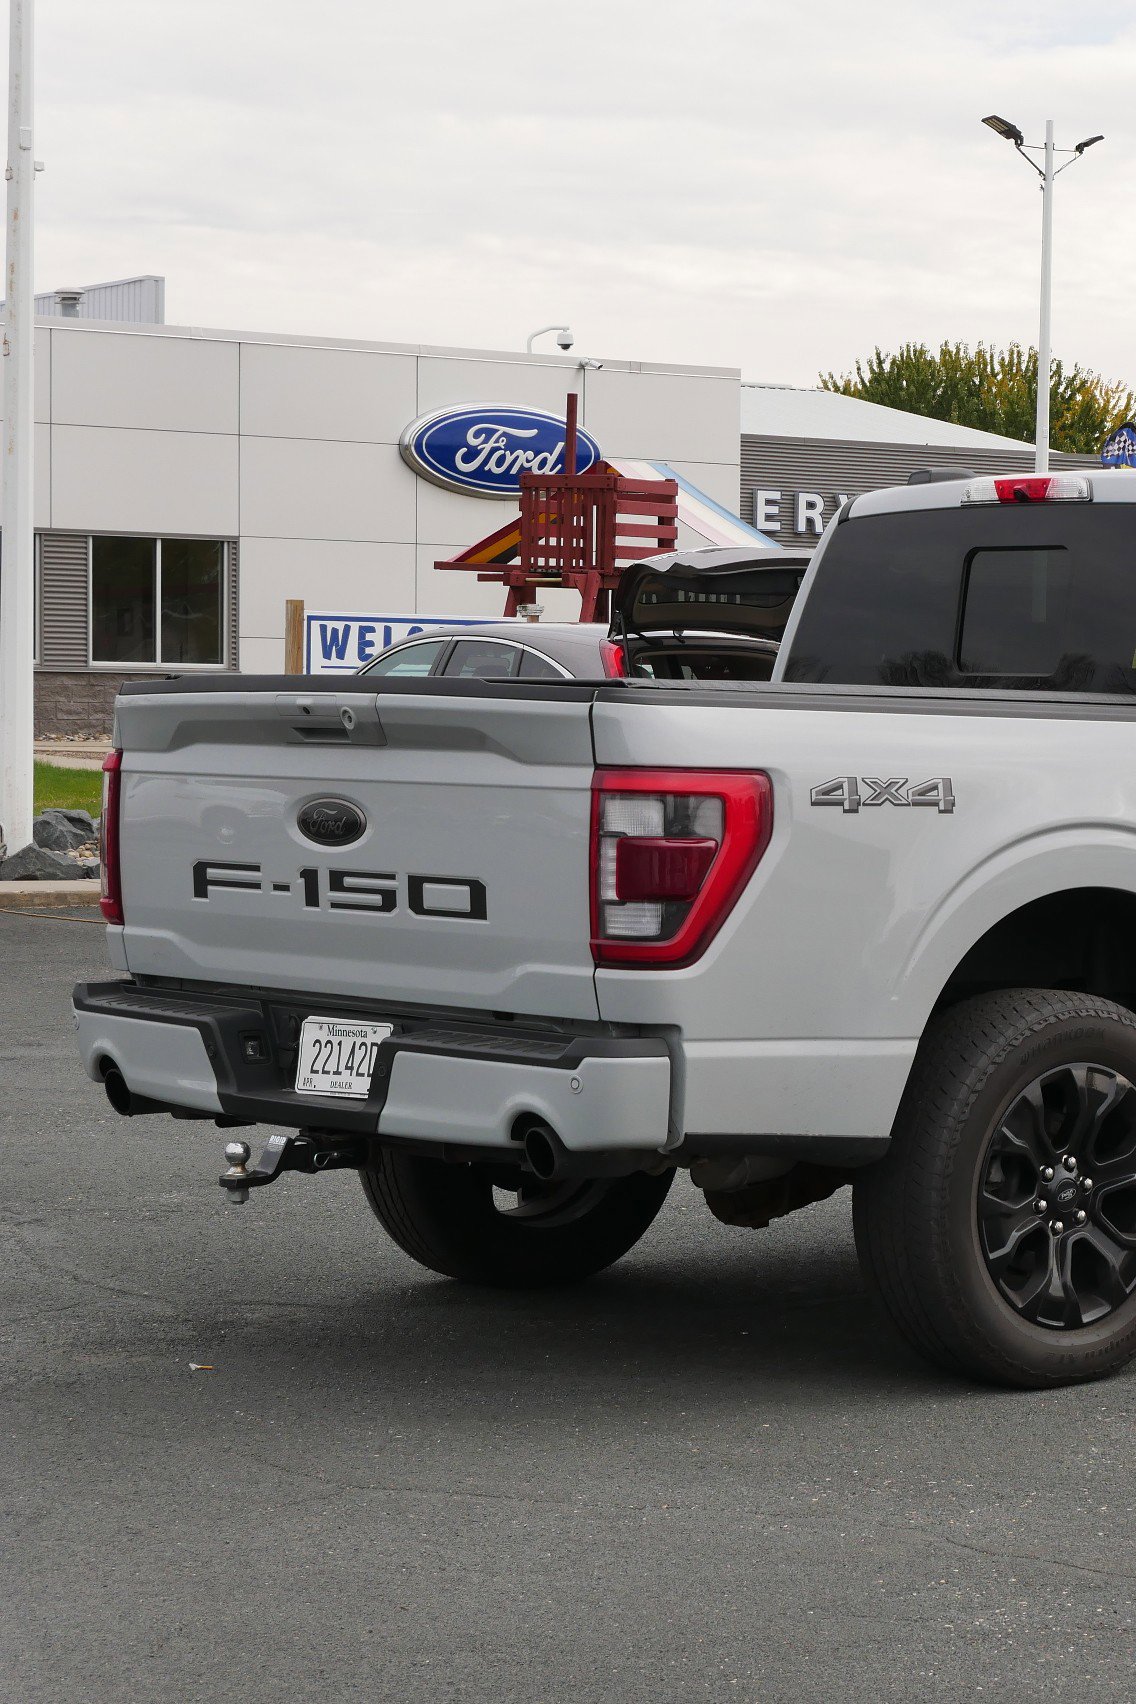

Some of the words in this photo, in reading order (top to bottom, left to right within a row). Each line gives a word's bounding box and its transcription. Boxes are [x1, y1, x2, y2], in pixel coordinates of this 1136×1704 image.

[455, 423, 565, 475] Ford
[753, 488, 849, 534] ER
[307, 808, 347, 833] Ford
[192, 861, 487, 921] F-150
[327, 1024, 368, 1039] Minnesota
[330, 1081, 353, 1089] DEALER
